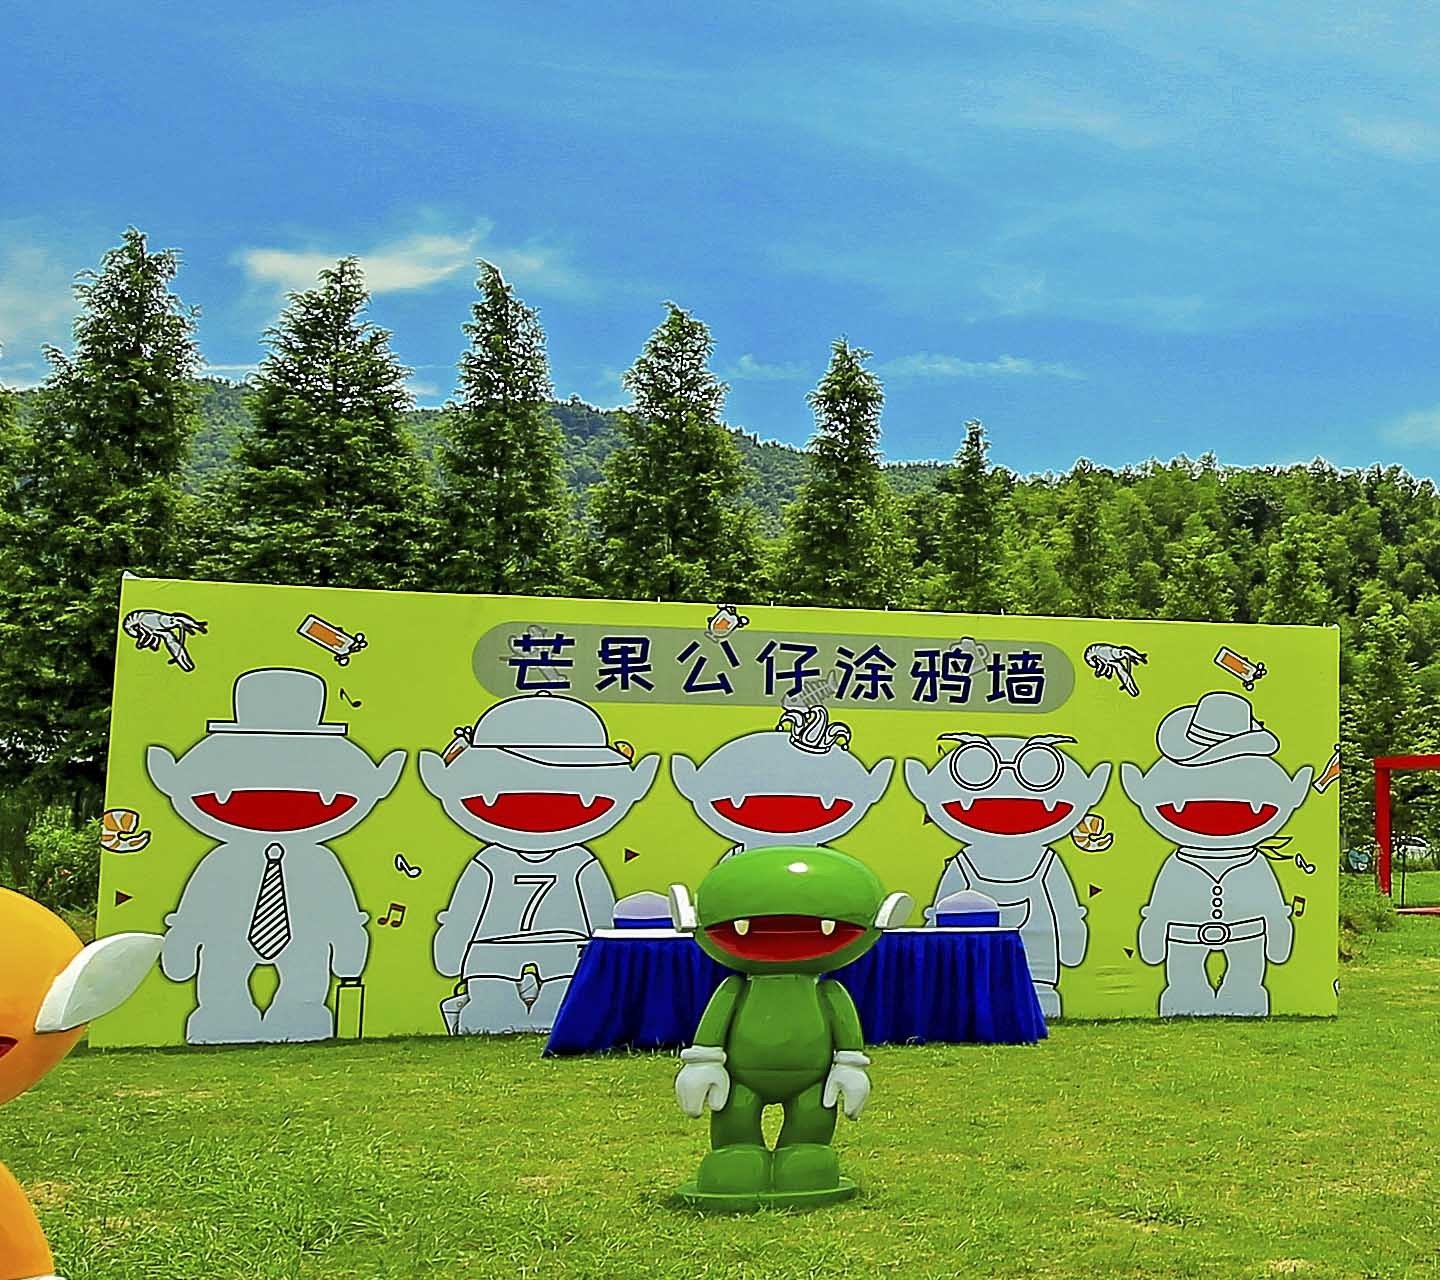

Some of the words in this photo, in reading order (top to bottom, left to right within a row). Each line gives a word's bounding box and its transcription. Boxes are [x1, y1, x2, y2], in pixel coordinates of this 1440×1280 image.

[508, 632, 1047, 705] 芒果公仔涂鸦墙
[513, 874, 558, 932] 7
